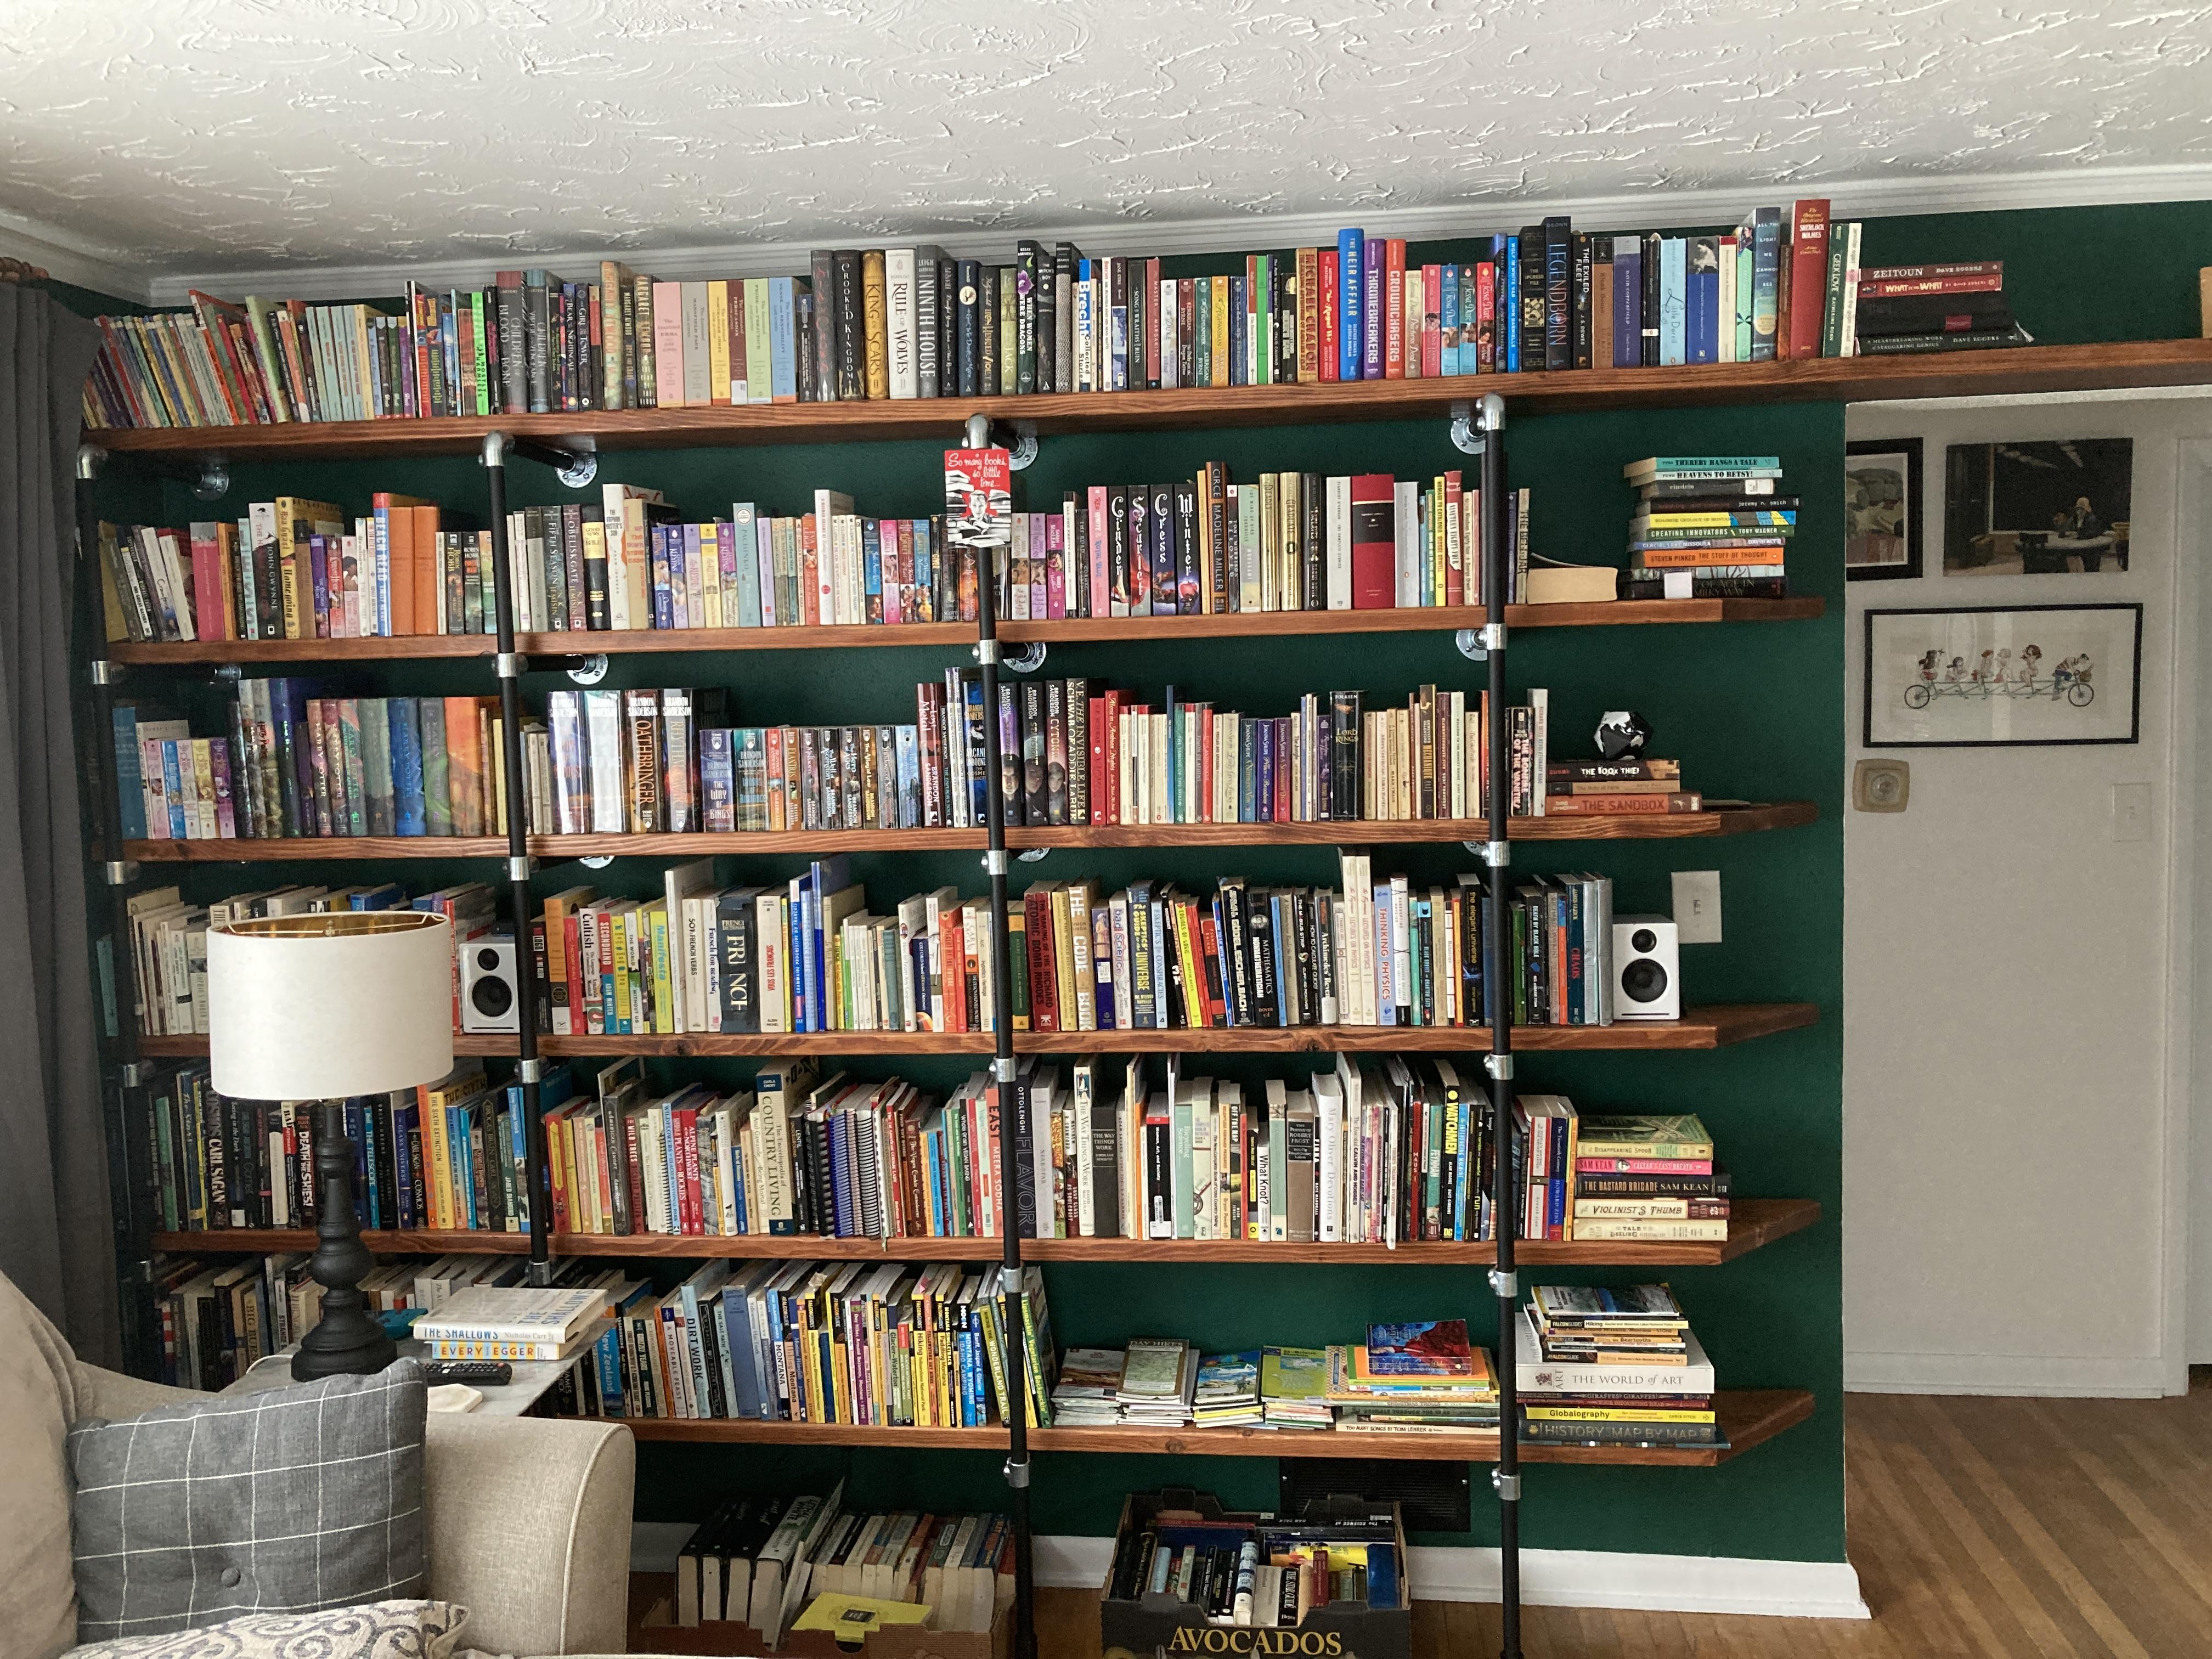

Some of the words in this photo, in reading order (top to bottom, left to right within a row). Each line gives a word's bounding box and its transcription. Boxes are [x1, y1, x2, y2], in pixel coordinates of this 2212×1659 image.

[1347, 251, 1357, 275] HEIR
[1833, 253, 1841, 273] GEEK
[1874, 268, 1923, 279] ZEITOUN
[842, 263, 854, 320] CROOKED
[1348, 279, 1357, 316] AFFAIR
[1548, 244, 1568, 345] LEGENDBORN
[1831, 273, 1841, 292] LOVE
[918, 280, 934, 325] NINTH
[1079, 281, 1091, 336] Brecht
[845, 324, 854, 380] KINGDOM
[919, 331, 935, 377] HOUSE
[1005, 347, 1014, 373] JACK
[948, 453, 963, 467] So
[964, 453, 982, 469] many
[983, 467, 1001, 477] little
[1212, 469, 1221, 497] CIRCE
[375, 517, 387, 551] BEACH
[567, 521, 577, 560] OBELISK
[1111, 496, 1124, 575] Cinder
[1132, 496, 1145, 595] Scarlet
[1155, 494, 1168, 563] Cress
[1178, 494, 1193, 577] Winter
[1213, 505, 1222, 555] MADELINE
[1686, 528, 1728, 537] INNOVATORS
[377, 554, 387, 581] READ
[570, 561, 578, 583] GATE
[1215, 557, 1223, 590] MILLER
[1067, 681, 1076, 726] SCHWAB
[1076, 701, 1085, 724] THE
[635, 720, 654, 805] OATHBRINGER
[1076, 725, 1085, 781] INVISIBLE
[925, 763, 933, 806] SANDERSON
[931, 766, 940, 803] BRANDON
[1521, 756, 1530, 793] BONFIRE
[1077, 783, 1085, 808] LIFE
[1582, 800, 1605, 812] THE
[1608, 799, 1665, 811] SANDBOX
[1071, 887, 1084, 918] THE
[1114, 909, 1124, 929] bad
[1468, 906, 1476, 932] elegant
[582, 913, 594, 949] Cultish
[600, 922, 612, 965] SECONDHAND
[1379, 908, 1389, 957] THINKING
[657, 925, 667, 980] Manifesta
[1073, 935, 1089, 975] CODE
[1115, 933, 1125, 975] science
[1252, 936, 1264, 998] NONMATHEMATICIAN
[1262, 940, 1272, 994] MATHEMATICS
[1571, 947, 1581, 979] CHAOS
[1136, 951, 1149, 991] UNIVERSE
[1381, 961, 1390, 1000] PHYSICS
[1077, 992, 1092, 1030] BOOK
[432, 1109, 440, 1126] SIXTH
[989, 1106, 1001, 1139] EAST
[1018, 1086, 1026, 1133] OTTOLENGHI
[298, 1131, 310, 1160] DEATH
[433, 1128, 442, 1161] EXTINCTION
[689, 1126, 697, 1152] ALPINE
[761, 1096, 776, 1163] COUNTRY
[1444, 1102, 1458, 1154] WATCHMEN
[208, 1138, 223, 1166] CARL
[684, 1136, 692, 1180] NORTHWEST
[691, 1154, 699, 1181] PLANTS
[992, 1147, 1002, 1176] MEERA
[1259, 1154, 1268, 1177] What
[1579, 1159, 1594, 1169] SAM
[1595, 1159, 1612, 1170] KEAN
[211, 1168, 225, 1203] SAGAN
[300, 1172, 313, 1207] SKIES!
[768, 1166, 781, 1216] LIVING
[1015, 1136, 1036, 1227] FLAVOR
[1259, 1179, 1269, 1205] Knot?
[1584, 1181, 1596, 1192] THE
[1599, 1181, 1627, 1192] BASTARD
[1629, 1181, 1658, 1192] BRIGADE
[1683, 1183, 1709, 1191] KEAN
[1593, 1205, 1646, 1215] VIOLINIST'S
[1650, 1206, 1682, 1215] THUMB
[686, 1318, 698, 1344] DIRT
[441, 1346, 482, 1356] EVERY
[493, 1347, 533, 1356] EGGER
[691, 1347, 703, 1379] WORK
[775, 1344, 786, 1385] MONTANA
[1021, 1299, 1034, 1338] Lipsmackin'
[1028, 1339, 1040, 1374] Vegetarian
[1034, 1374, 1047, 1414] Backpackin'
[603, 1353, 614, 1392] Zealand
[989, 1340, 1003, 1391] WONDERLAND
[998, 1392, 1008, 1414] TRAIL
[1572, 1375, 1595, 1384] THE
[1599, 1375, 1644, 1384] WORLD
[1648, 1374, 1657, 1385] of
[1662, 1376, 1684, 1385] ART
[1549, 1409, 1610, 1419] Globalography
[1545, 1426, 1604, 1437] HISTORY
[1612, 1427, 1641, 1439] MAP
[1645, 1429, 1662, 1439] BY
[1667, 1430, 1697, 1439] MAP
[1169, 1626, 1342, 1655] AVOCADOS
